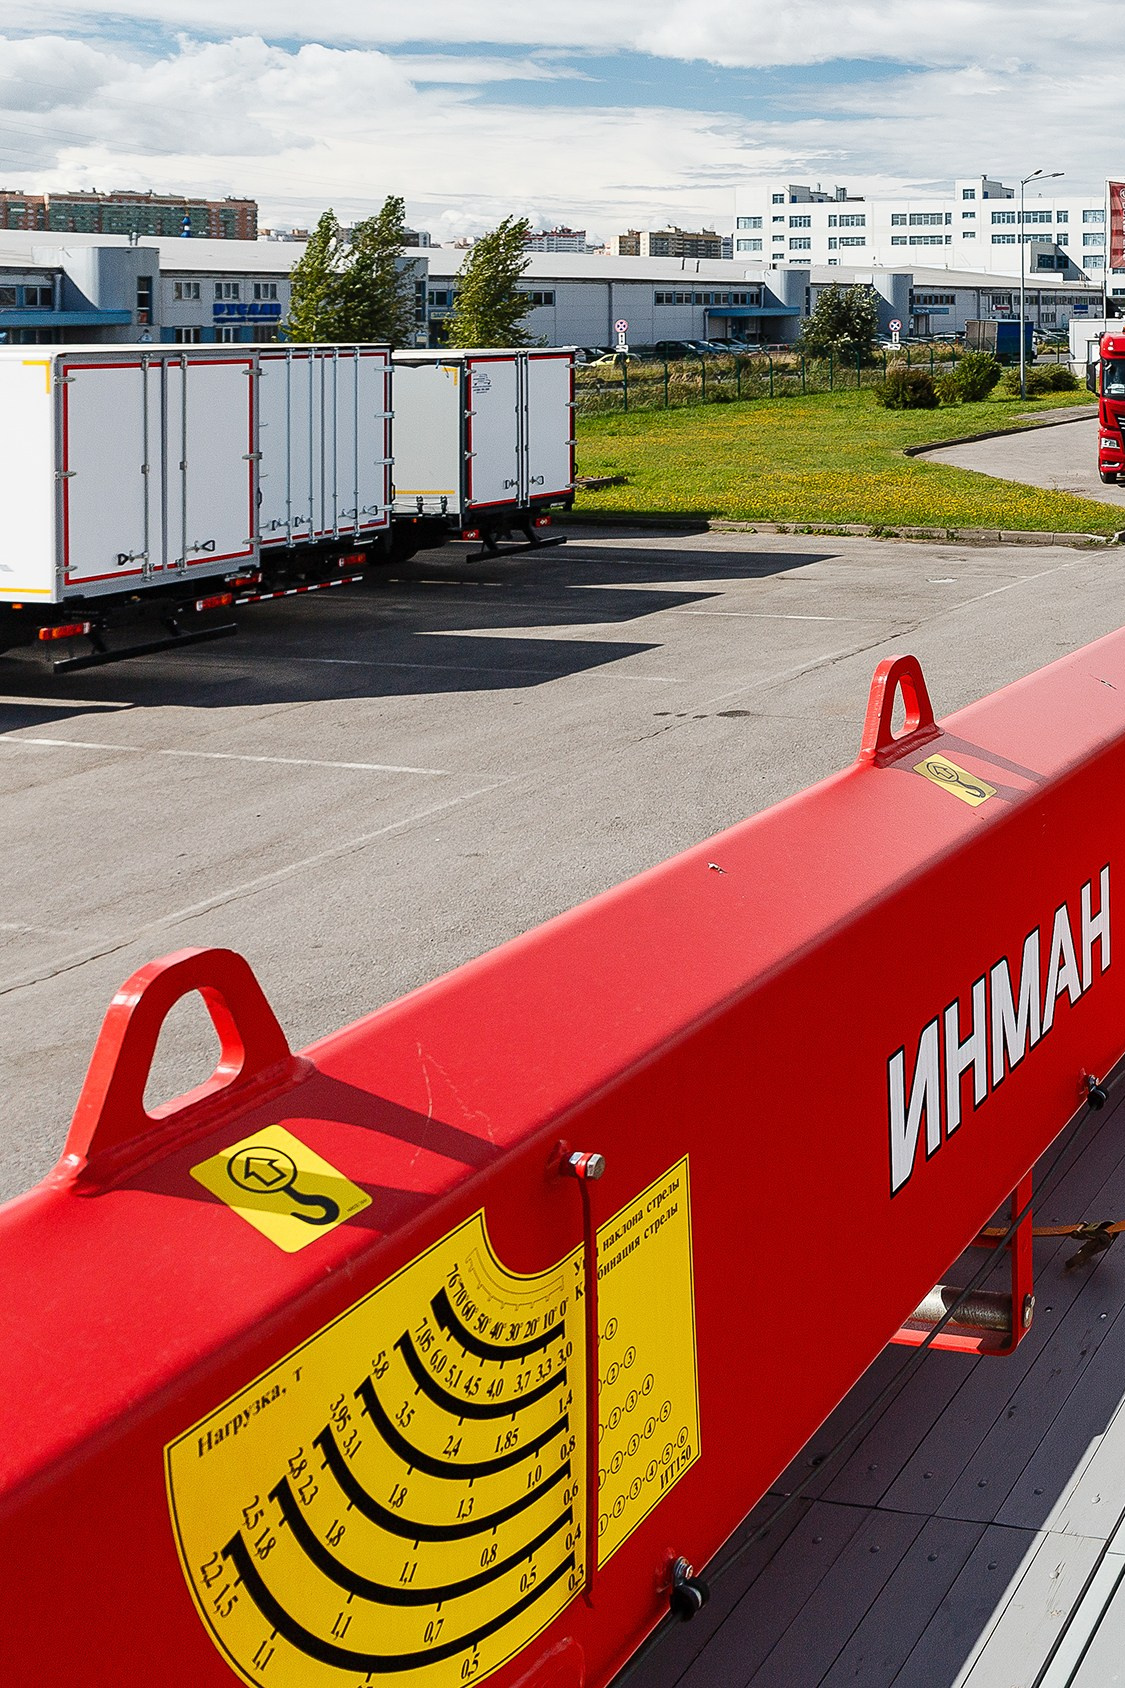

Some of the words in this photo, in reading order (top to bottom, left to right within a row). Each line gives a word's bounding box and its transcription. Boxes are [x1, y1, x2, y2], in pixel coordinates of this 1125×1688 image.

[213, 303, 282, 316] РУСЛАН
[887, 863, 1111, 1199] ИНМАН
[602, 1209, 644, 1252] наклона
[646, 1178, 680, 1213] стрелы
[644, 1202, 678, 1239] стрелы
[415, 1317, 435, 1353] 7,05
[430, 1348, 448, 1374] 6,0
[444, 1364, 463, 1388] 5,1
[463, 1375, 482, 1398] 4,5
[486, 1378, 504, 1401] 4,0
[513, 1370, 531, 1395] 3,7
[535, 1358, 552, 1382] 3,3
[557, 1341, 573, 1367] 3,0
[461, 1300, 478, 1321] 60°
[473, 1313, 492, 1334] 50°
[489, 1322, 506, 1340] 40°
[505, 1322, 523, 1342] 30°
[523, 1317, 541, 1339] 20°
[543, 1306, 558, 1330] 10°
[197, 1384, 287, 1457] Нагрузка,
[292, 1366, 303, 1382] т
[371, 1350, 390, 1379] 5,8
[395, 1400, 415, 1428] 3,5
[442, 1434, 463, 1459] 2,4
[494, 1427, 520, 1453] 1,85
[330, 1393, 352, 1433] 3,95
[343, 1429, 362, 1460] 3,1
[388, 1483, 408, 1509] 1,8
[455, 1497, 475, 1521] 1,3
[526, 1465, 542, 1489] 1,0
[560, 1434, 576, 1461] 0,8
[660, 1444, 692, 1490] ИТ150
[287, 1447, 308, 1480] 2,8
[298, 1474, 319, 1505] 2,3
[325, 1519, 346, 1547] 1,8
[399, 1561, 418, 1586] 1,1
[480, 1543, 498, 1568] 0,8
[563, 1480, 579, 1506] 0,6
[200, 1551, 223, 1589] 2,2
[213, 1584, 239, 1618] 1,5
[252, 1640, 275, 1671] 1,1
[460, 1652, 481, 1680] 0,5
[568, 1563, 584, 1592] 0,3
[242, 1495, 264, 1530] 2,5
[254, 1527, 276, 1560] 1,8
[330, 1611, 352, 1641] 1,1
[423, 1618, 445, 1645] 0,7
[519, 1565, 537, 1593] 0,5
[565, 1522, 582, 1551] 0,4
